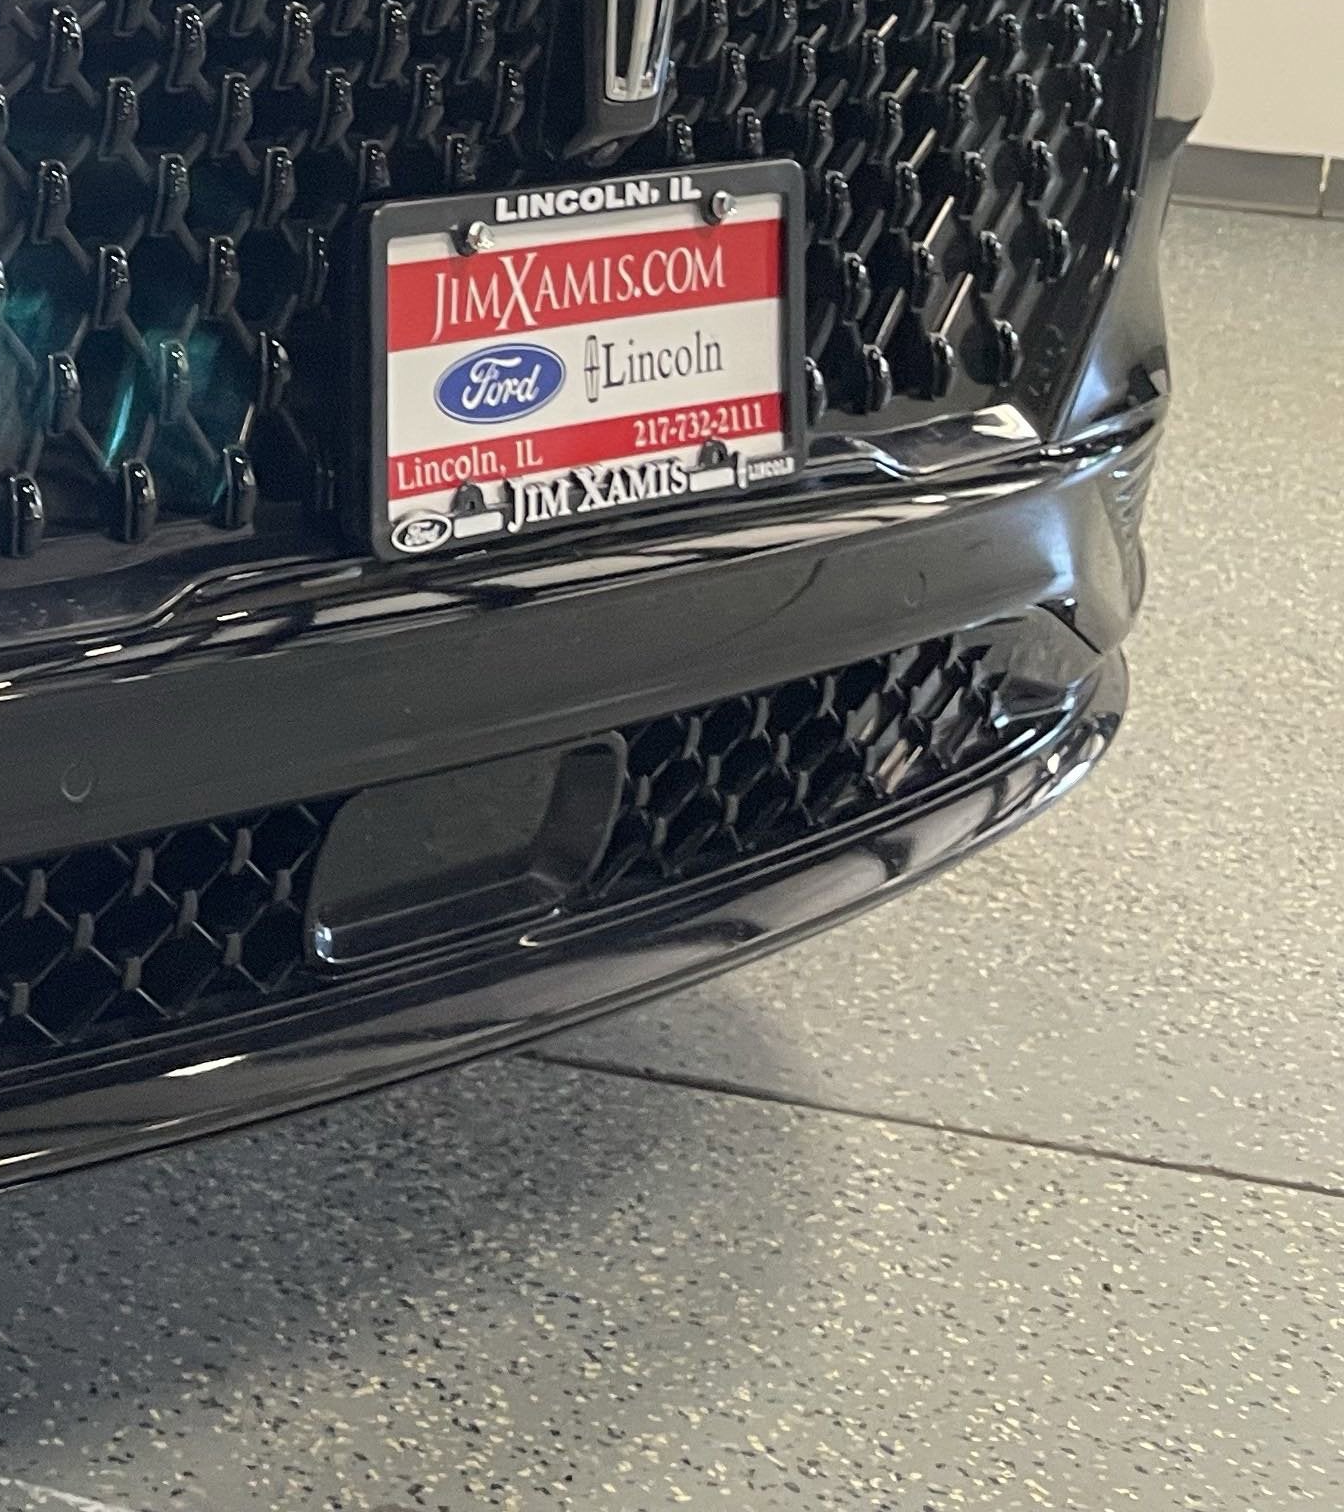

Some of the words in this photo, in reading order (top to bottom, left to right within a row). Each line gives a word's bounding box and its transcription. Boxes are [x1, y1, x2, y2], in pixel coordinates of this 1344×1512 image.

[495, 180, 660, 222] LINCOLN,
[668, 176, 702, 202] IL
[461, 356, 541, 410] Ford
[602, 331, 724, 389] Lincoln
[633, 402, 765, 448] 217-732-2111
[396, 444, 507, 490] Lincoln,
[516, 440, 544, 468] IL
[507, 478, 573, 534] JIM
[579, 462, 689, 511] XAMIS
